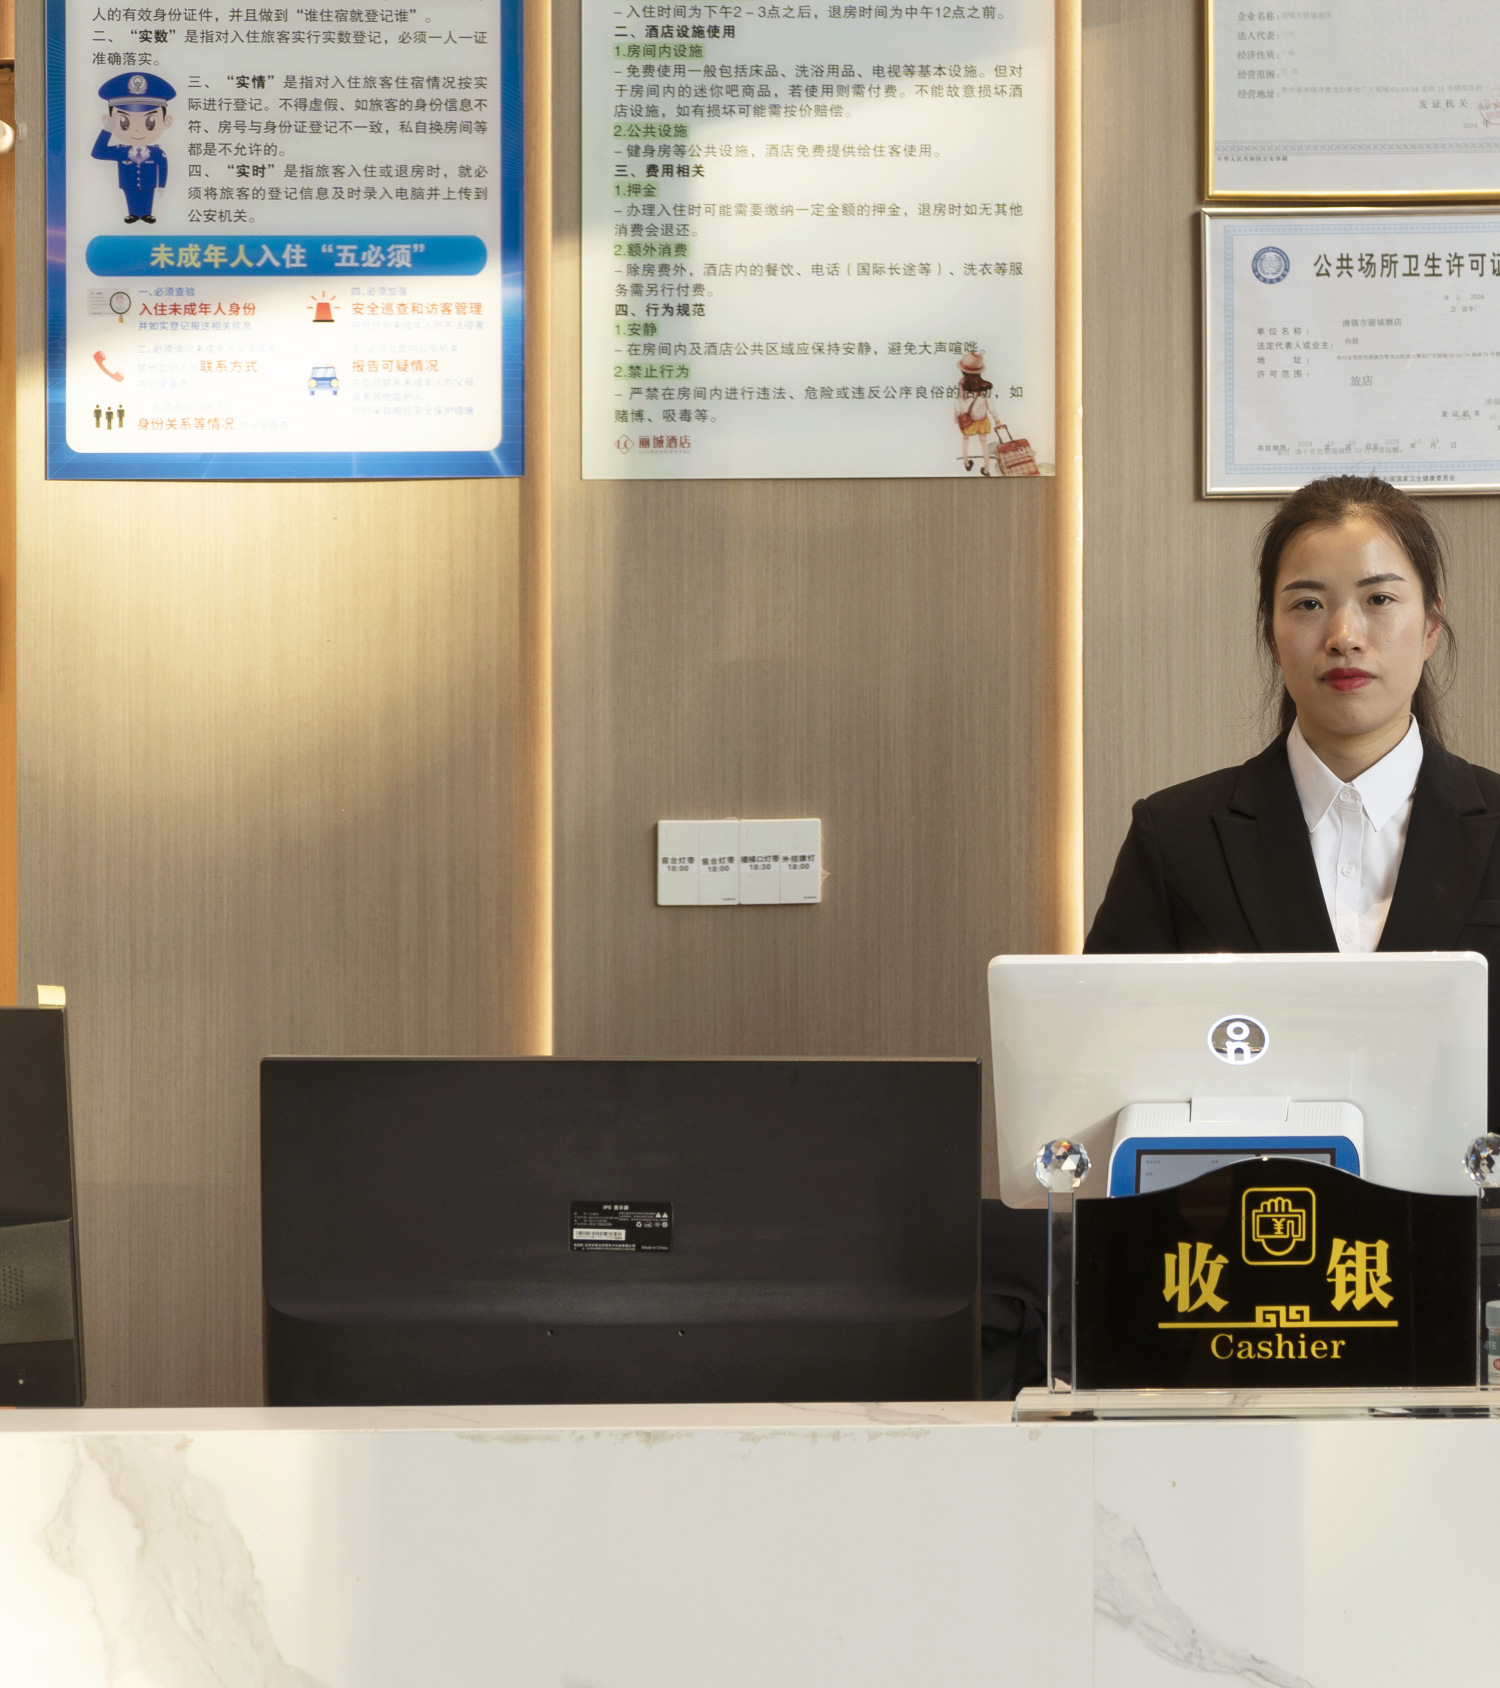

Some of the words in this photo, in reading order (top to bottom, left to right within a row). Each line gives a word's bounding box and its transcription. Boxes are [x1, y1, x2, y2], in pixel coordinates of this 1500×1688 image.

[614, 24, 736, 39] 二、酒店设施使用
[92, 51, 161, 67] 准确落实。
[614, 44, 704, 59] 1.房间内设施
[1419, 99, 1468, 109] 发证机关
[614, 123, 688, 138] 2.公共设施
[188, 141, 285, 158] 都是不允许的。
[614, 163, 706, 178] 三、费用相关
[188, 185, 488, 202] 须将旅客的登记信息及时录入电脑并上传到
[614, 182, 656, 197] 1.押金
[188, 208, 256, 224] 公安机关。
[614, 223, 698, 238] 消费会退还。
[150, 243, 425, 270] 未成年人入住“五必须”
[614, 242, 688, 258] 2.额外消费
[614, 282, 714, 298] 务需另行付费。
[138, 301, 257, 317] 入住未成年人身份
[351, 302, 483, 316] 安全巡查和访客管理
[614, 302, 706, 317] 四、行为规范
[614, 322, 657, 337] 1.安静
[352, 360, 440, 373] 报告可疑情况
[614, 364, 690, 379] 2.禁止行为
[1350, 375, 1373, 387] 旅店
[614, 408, 718, 424] 赌博、吸毒等。
[137, 417, 235, 431] 身份关系等情况
[639, 435, 691, 449] 丽城酒店
[1210, 1333, 1346, 1360] Cashier
